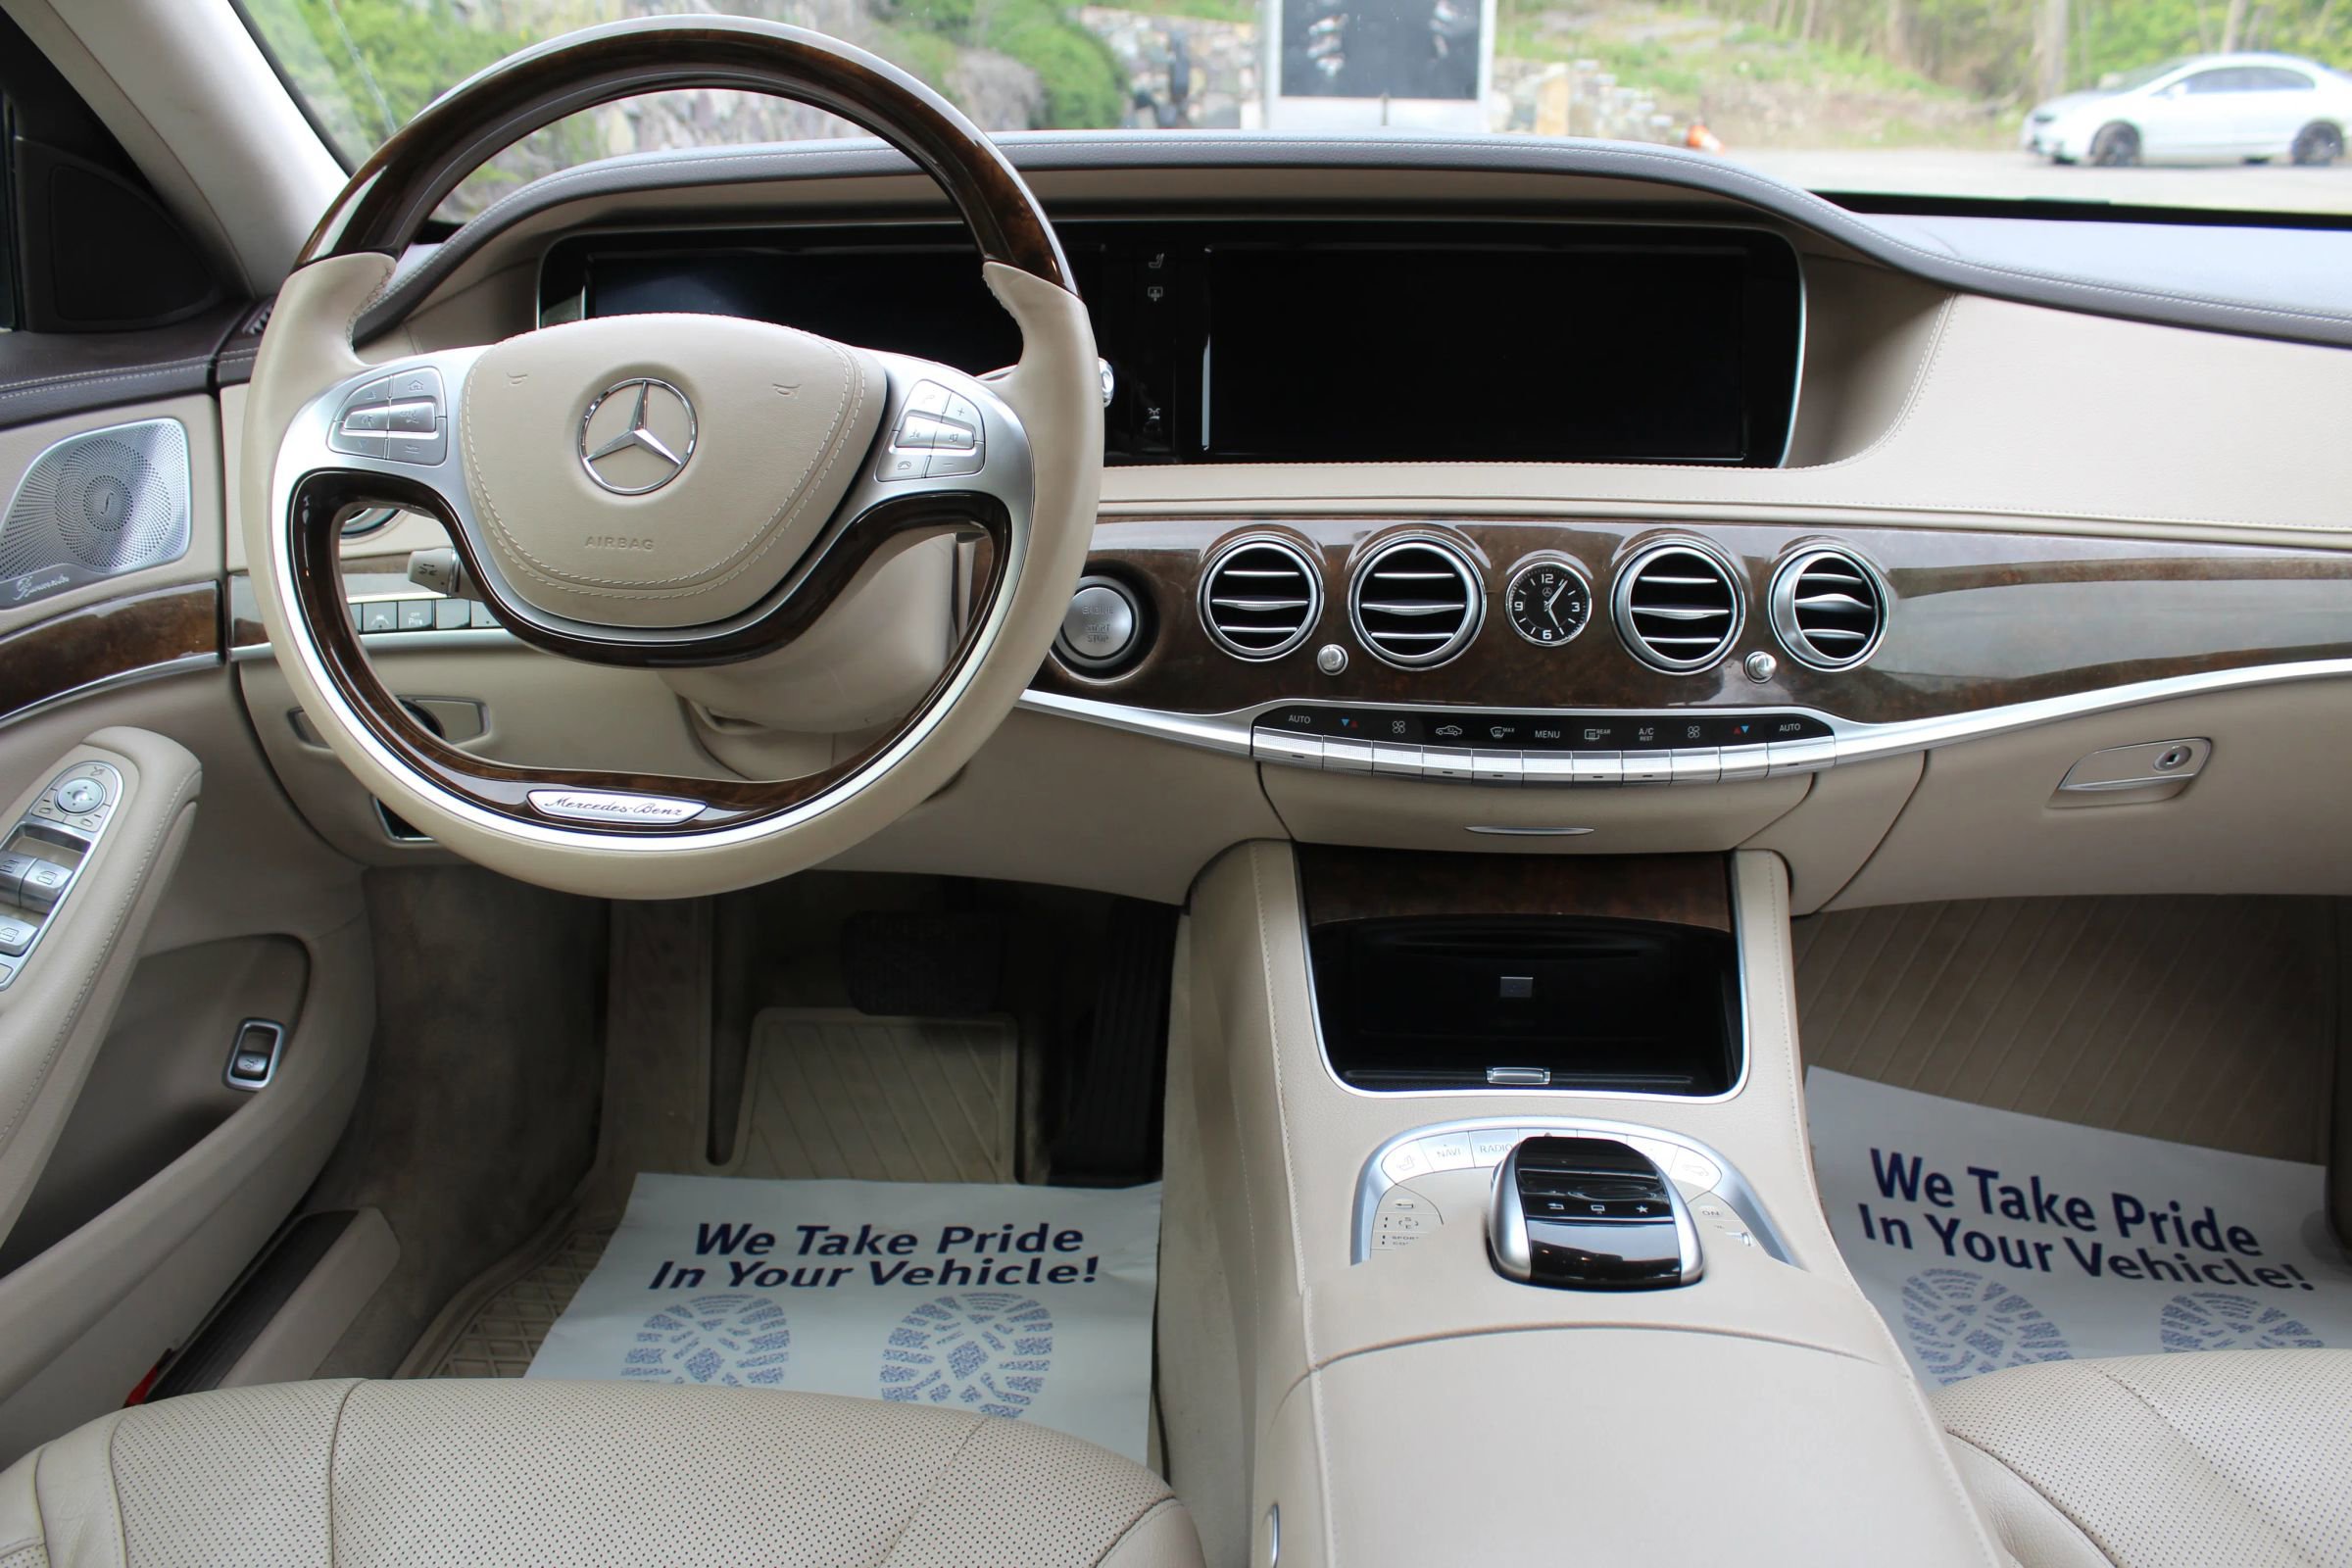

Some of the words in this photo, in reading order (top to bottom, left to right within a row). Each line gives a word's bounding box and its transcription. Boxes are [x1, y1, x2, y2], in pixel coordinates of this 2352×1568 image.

[584, 536, 654, 551] AIRBAG
[1541, 573, 1554, 584] 12
[1514, 601, 1524, 612] 9
[1571, 602, 1581, 612] 3
[1542, 629, 1552, 640] 6
[1288, 714, 1311, 724] AUTO
[1639, 727, 1654, 736] A/C
[1779, 722, 1801, 732] AUTO
[1535, 730, 1560, 739] MENU
[544, 796, 683, 815] Mercedes-Benz
[1437, 1148, 1461, 1156] NAVI
[1480, 1143, 1513, 1153] RADIO
[1869, 1148, 1954, 1208] We
[1967, 1165, 2095, 1233] Take
[2111, 1193, 2264, 1257] Pride
[695, 1222, 776, 1256] We
[796, 1223, 919, 1256] Take
[936, 1222, 1085, 1254] Pride
[1858, 1202, 1913, 1250] In
[1924, 1213, 2053, 1273] Your
[2063, 1237, 2315, 1292] Vehicle!
[648, 1260, 705, 1289] In
[727, 1260, 853, 1288] Your
[869, 1255, 1100, 1286] Vehicle!
